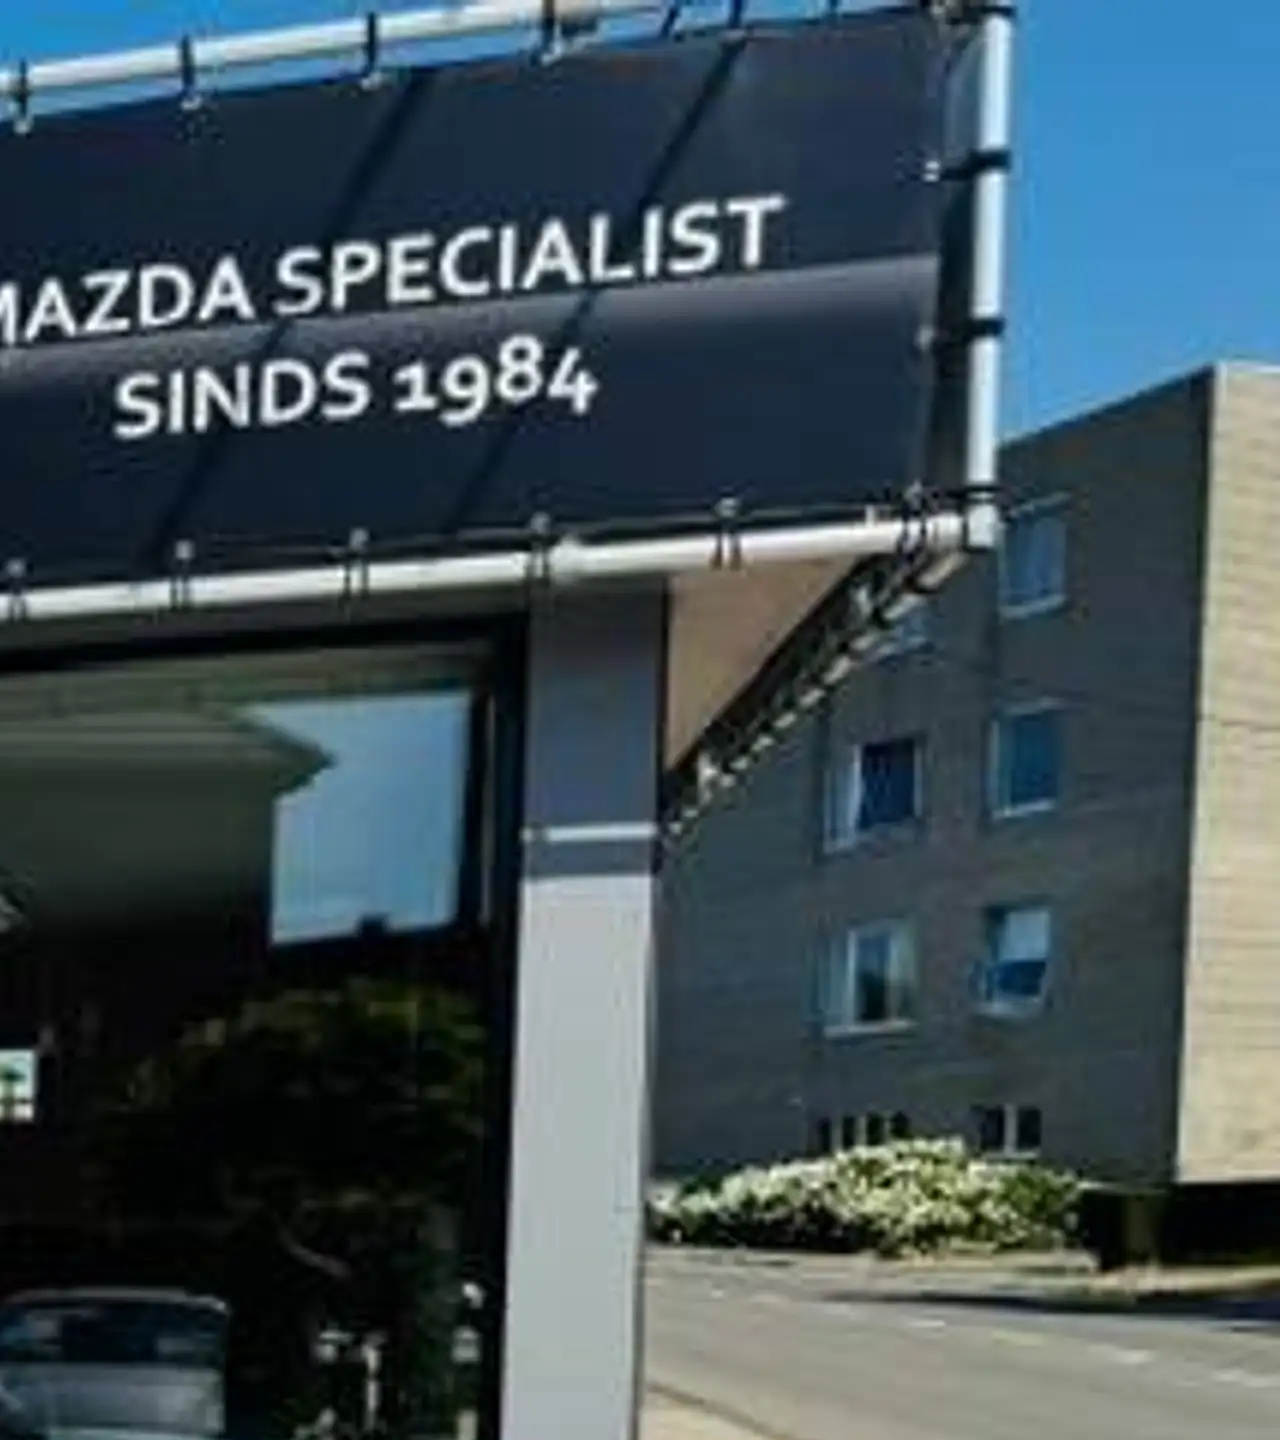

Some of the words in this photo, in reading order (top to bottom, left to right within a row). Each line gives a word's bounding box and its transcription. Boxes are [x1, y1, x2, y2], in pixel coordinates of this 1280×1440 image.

[273, 193, 786, 315] SPECIALIST
[112, 352, 371, 438] SINDS
[393, 333, 597, 426] 1984
